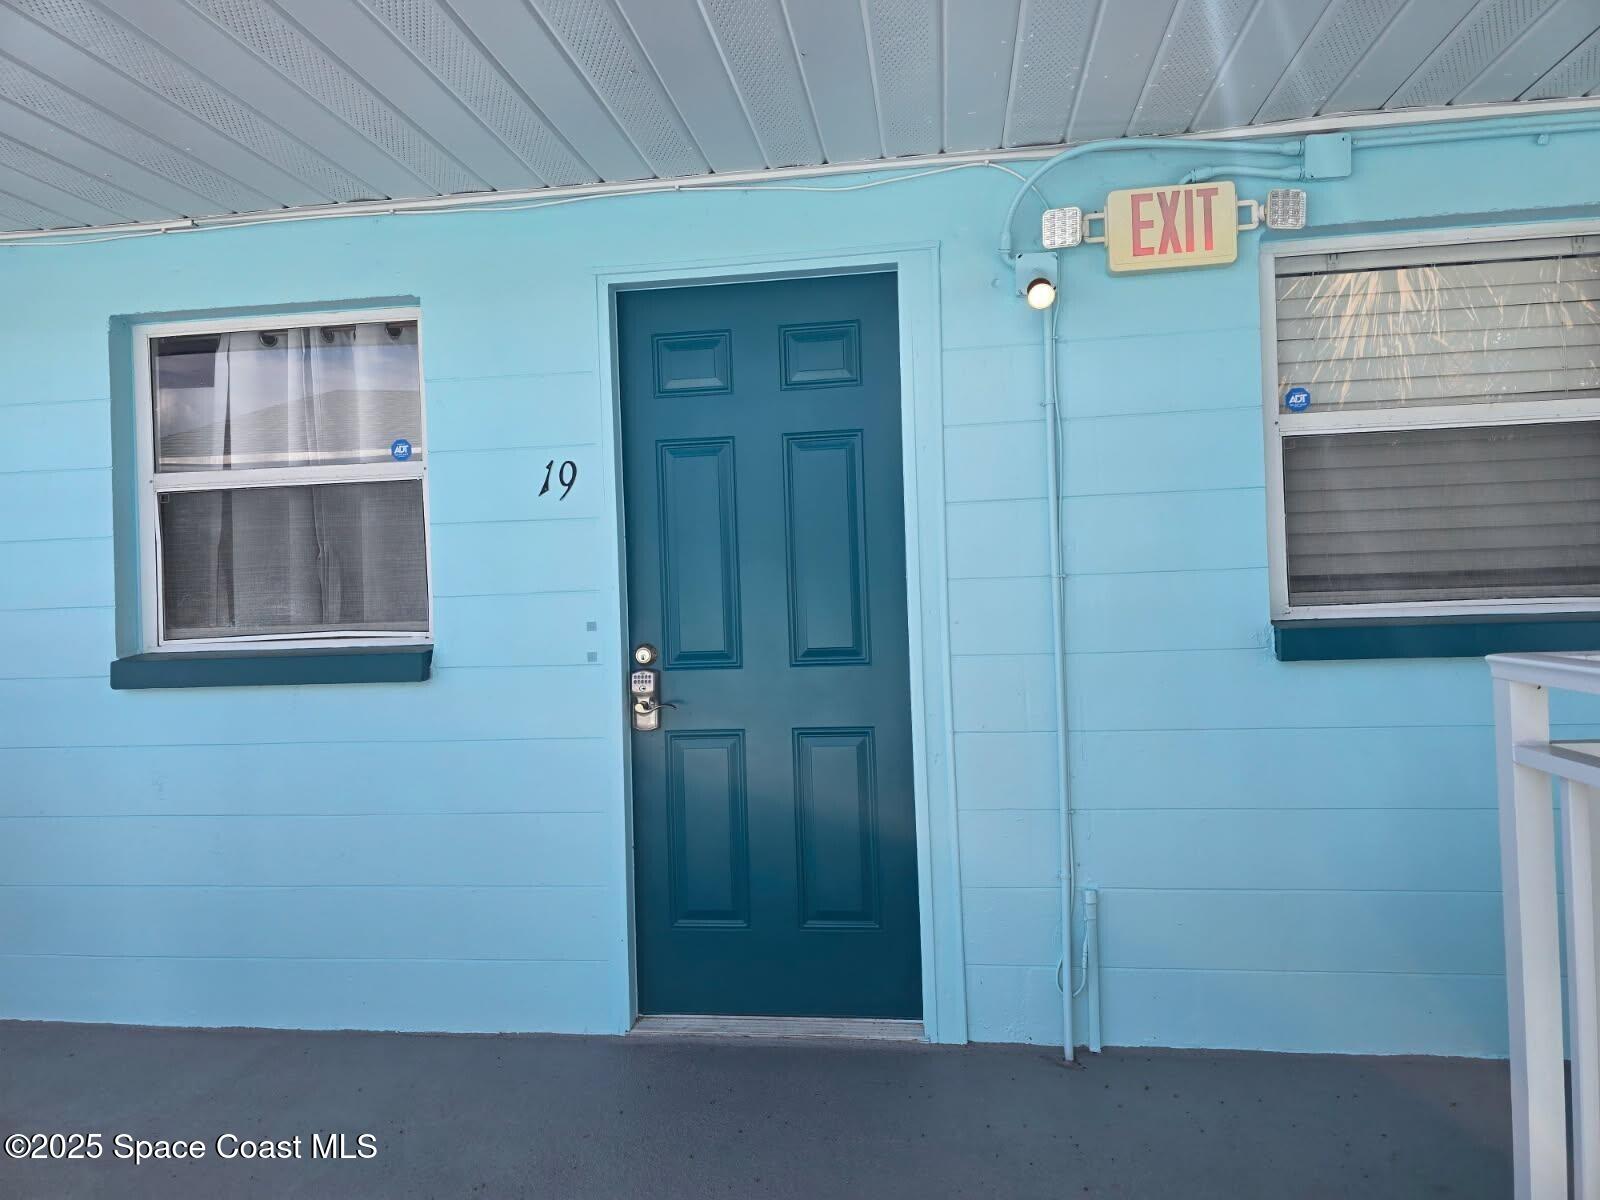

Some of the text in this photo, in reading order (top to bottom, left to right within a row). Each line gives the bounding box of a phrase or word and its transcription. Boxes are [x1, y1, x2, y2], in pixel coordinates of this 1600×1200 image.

[1131, 187, 1219, 257] EXIT
[1289, 393, 1308, 404] ADT
[394, 444, 409, 454] ADT
[538, 459, 577, 501] 19
